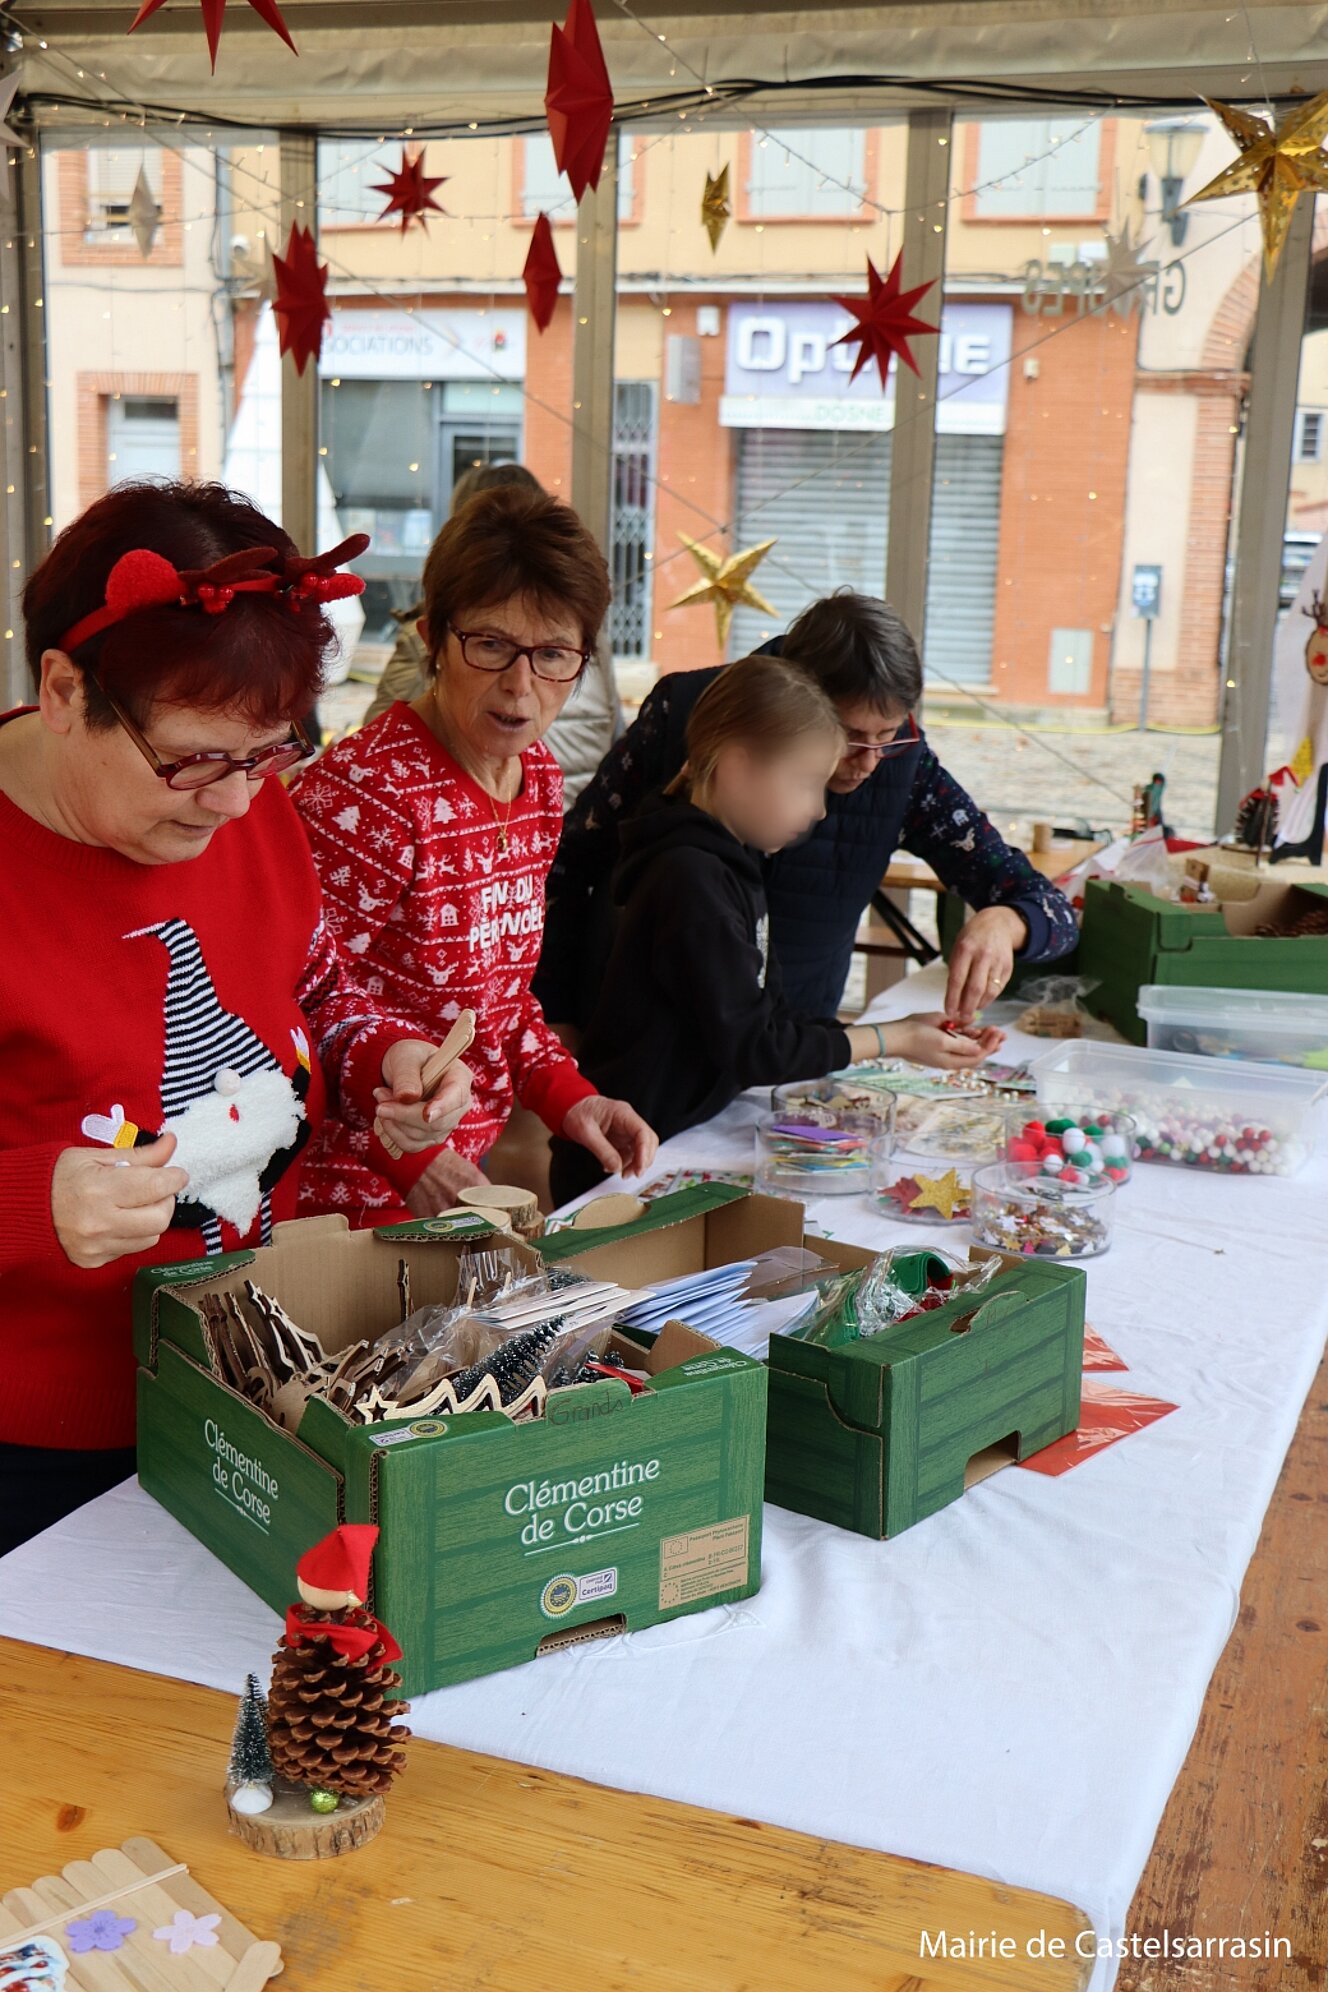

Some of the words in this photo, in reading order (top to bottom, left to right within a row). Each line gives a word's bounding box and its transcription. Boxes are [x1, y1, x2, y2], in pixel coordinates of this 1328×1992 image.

[204, 1418, 279, 1499] Clémentine
[212, 1456, 228, 1489] de
[232, 1471, 271, 1524] Corse
[504, 1459, 660, 1515] Clémentine
[520, 1514, 555, 1545] de
[564, 1495, 643, 1532] Corse
[581, 1582, 613, 1597] Certipaq
